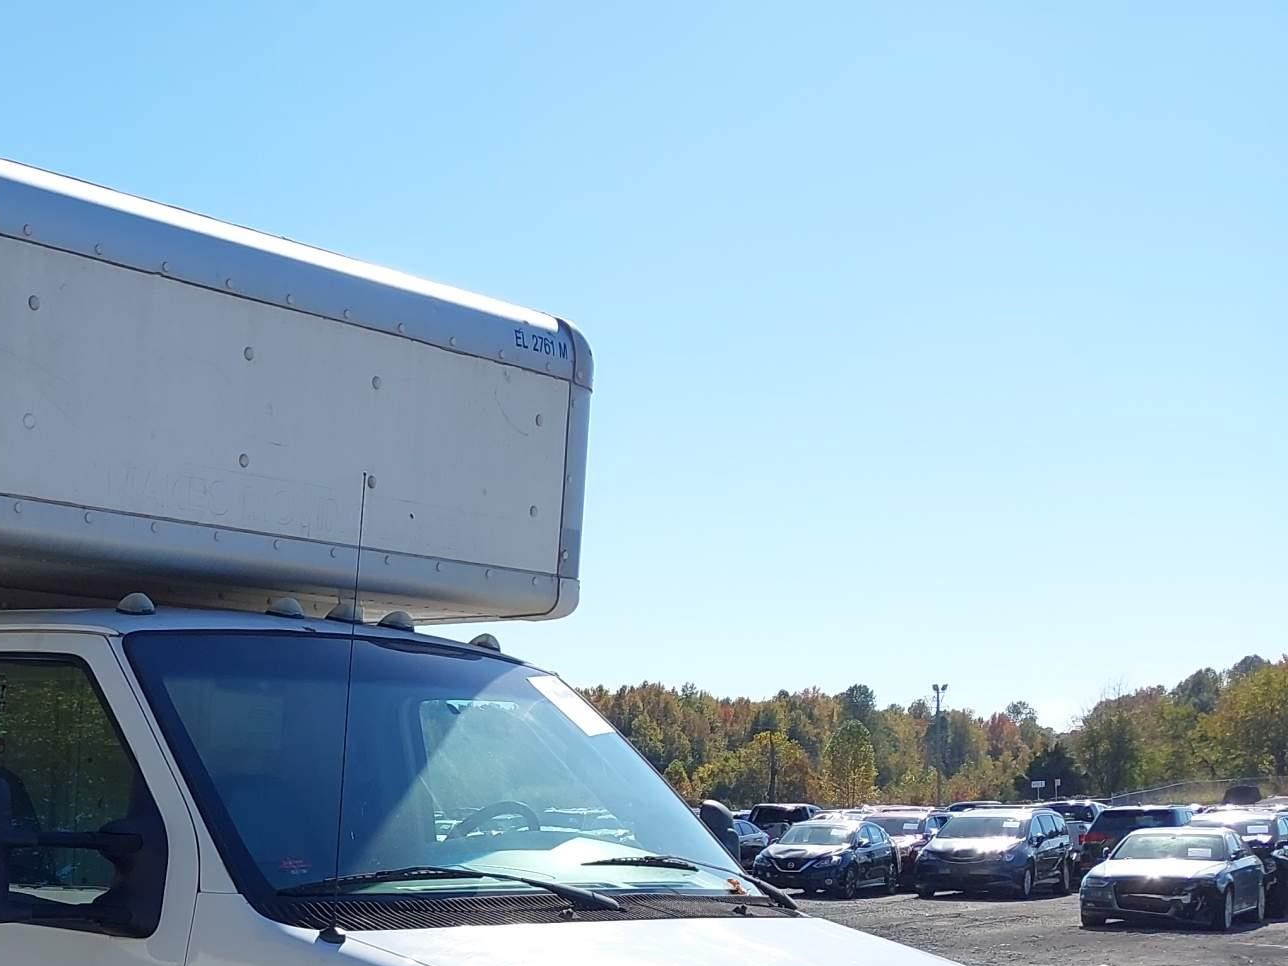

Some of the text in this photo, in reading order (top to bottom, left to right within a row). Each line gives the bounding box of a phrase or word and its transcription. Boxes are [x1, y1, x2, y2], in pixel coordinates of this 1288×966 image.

[514, 328, 568, 360] EL 2761 M
